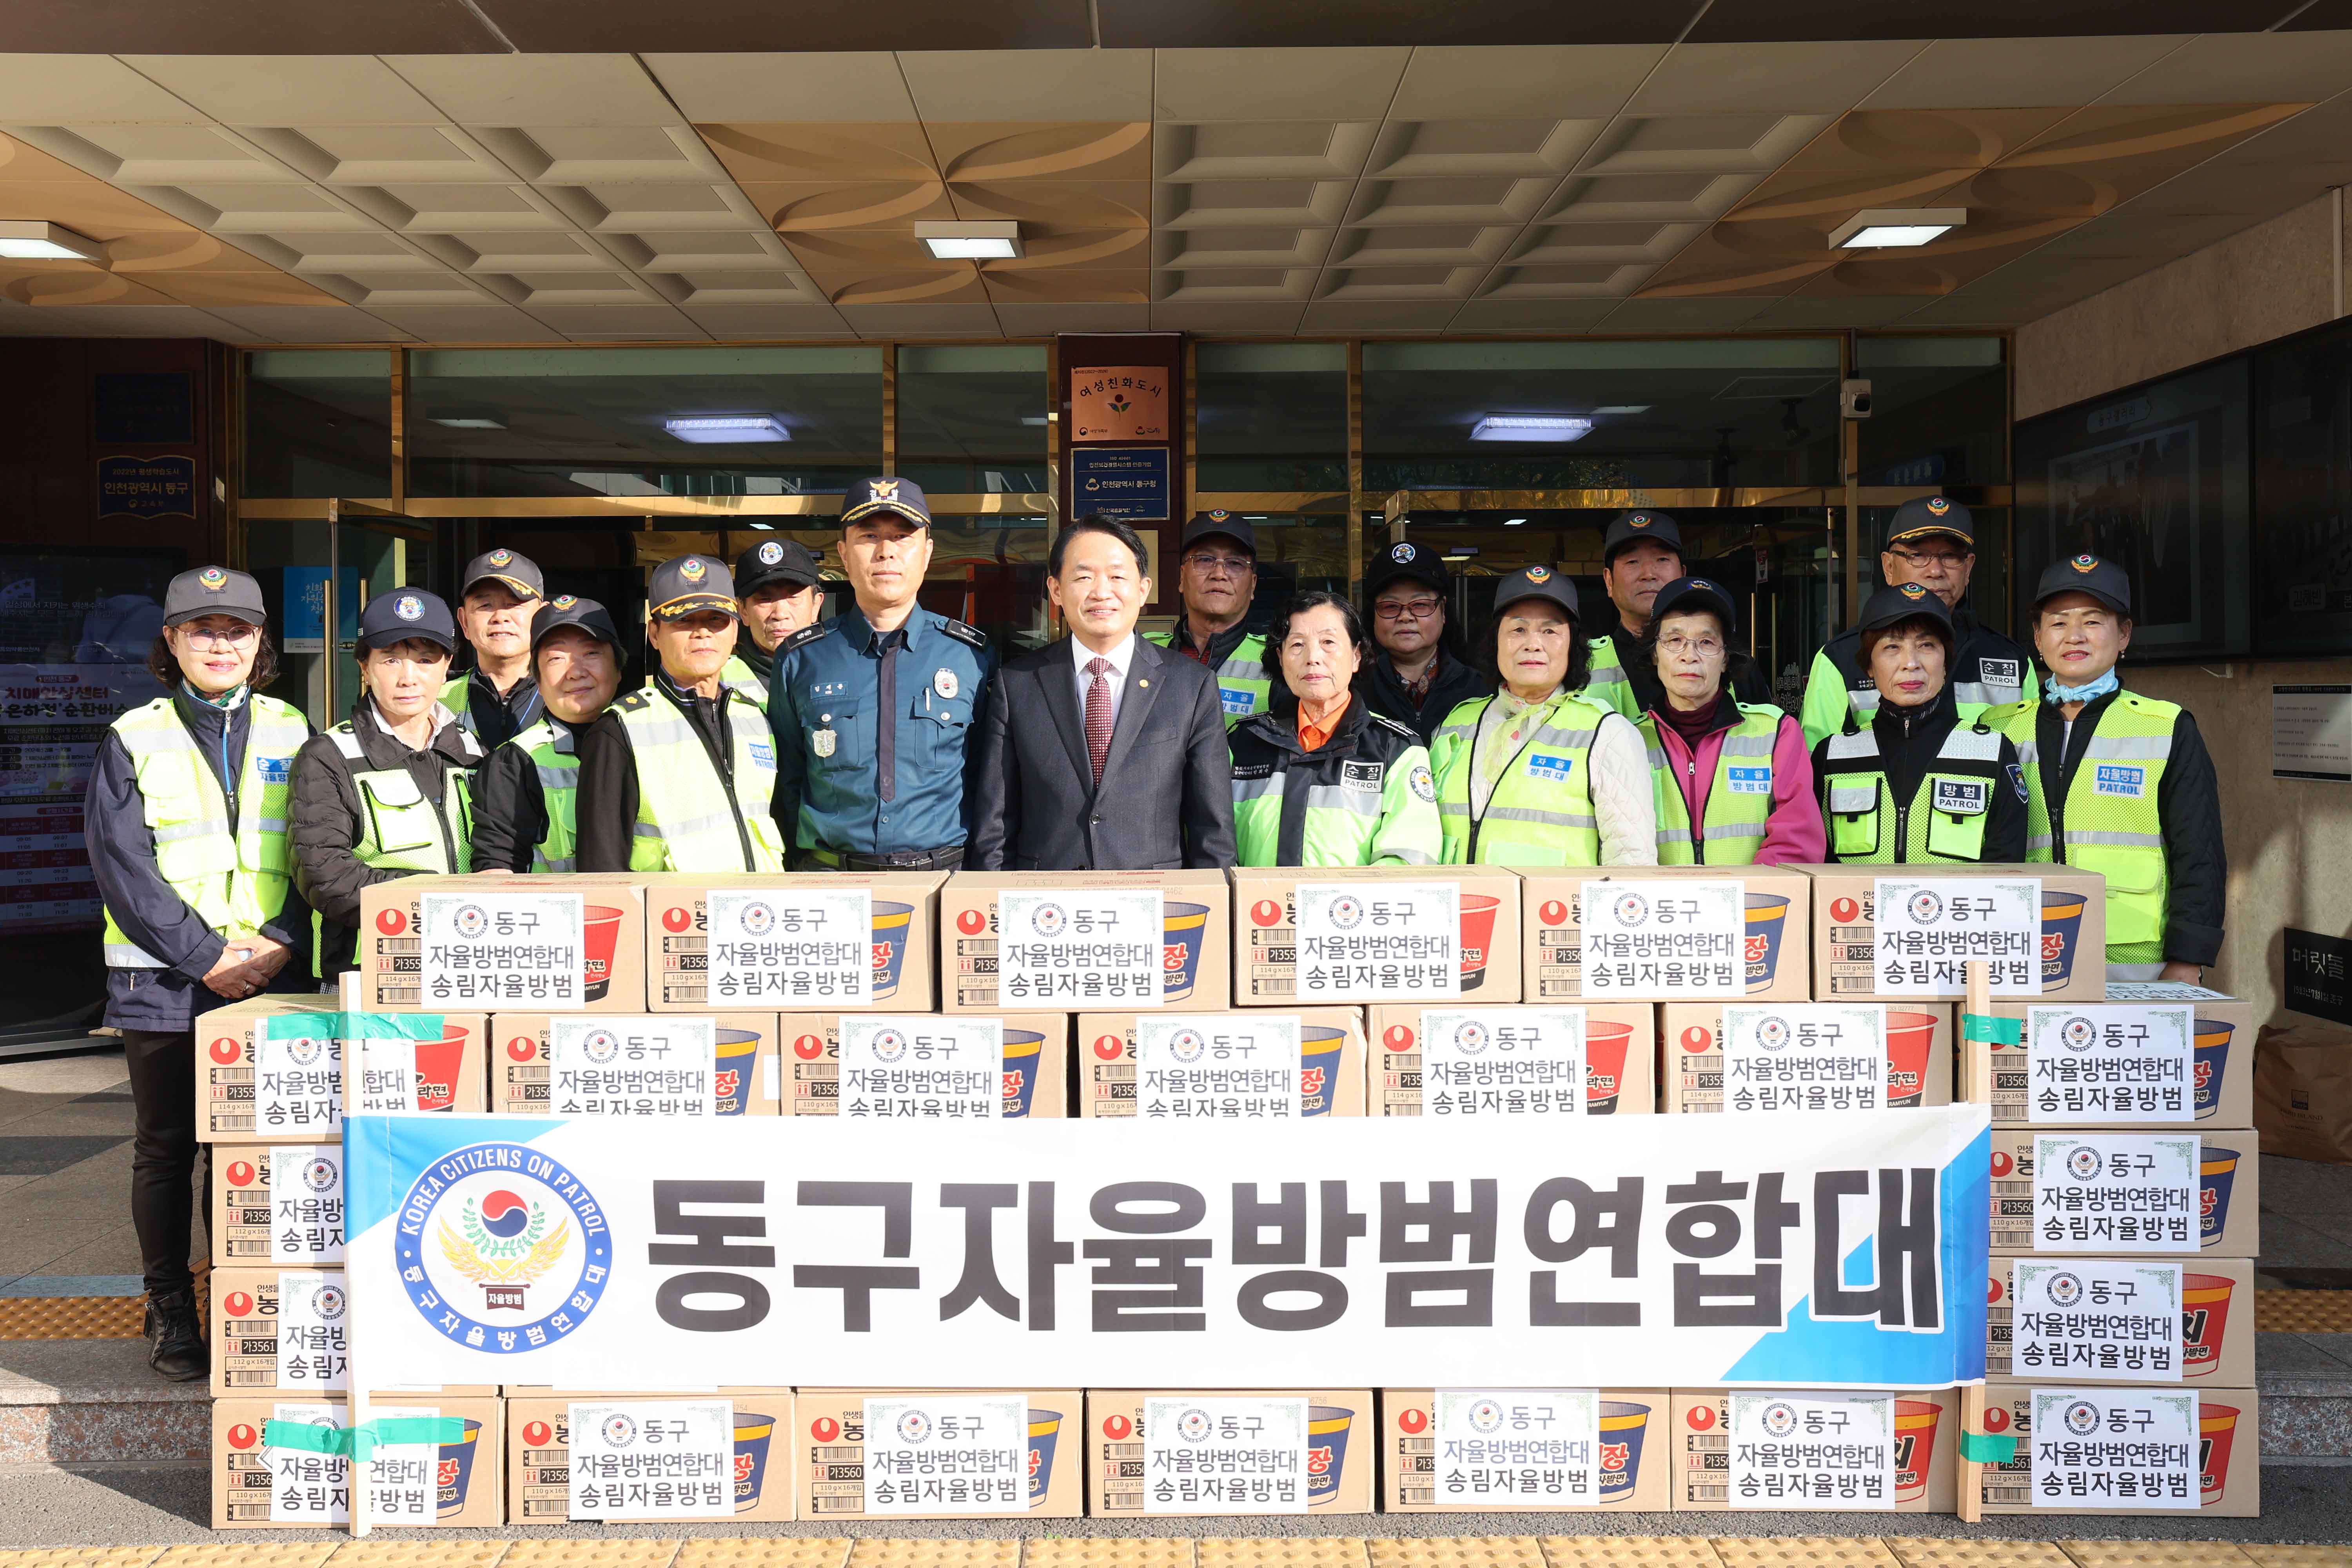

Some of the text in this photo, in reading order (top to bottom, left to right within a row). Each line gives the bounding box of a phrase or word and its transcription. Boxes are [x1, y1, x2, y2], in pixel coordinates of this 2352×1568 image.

[1080, 377, 1162, 397] 여성친화도시
[104, 482, 188, 495] 인천광역시 동구
[1102, 480, 1156, 488] 인천광역시 동구청
[1984, 662, 2014, 675] 순찰
[1985, 675, 2014, 684] PATROL
[5, 686, 109, 700] 치매안심센터
[1224, 692, 1248, 702] 자율
[1346, 766, 1379, 779] 순찰
[1530, 768, 1564, 780] 방범대
[1536, 758, 1565, 769] 자율
[1735, 770, 1764, 779] 자율
[260, 772, 289, 782] 자율방
[1345, 779, 1377, 788] PATROL
[1733, 782, 1768, 791] 방범대
[2099, 768, 2140, 783] 자율방범
[1944, 784, 1975, 798] 방범
[2099, 783, 2139, 794] PATROL
[1940, 799, 1980, 809] PATROL
[782, 909, 827, 932] 동구
[1370, 903, 1416, 925] 동구
[1656, 900, 1700, 923] 동구
[1950, 898, 1996, 921] 동구
[495, 912, 540, 935] 동구
[1074, 910, 1119, 933] 동구
[717, 942, 860, 966] 자율방범연합대
[1305, 936, 1449, 960] 자율방범연합대
[1590, 933, 1733, 957] 자율방범연합대
[1849, 946, 1874, 958] 가356
[1882, 931, 2030, 955] 자율방범연합대
[395, 958, 421, 971] 가355
[430, 945, 573, 969] 자율방범연합대
[682, 956, 707, 969] 가356
[1007, 944, 1152, 967] 자율방범연합대
[1270, 949, 1296, 961] 가355
[2292, 947, 2344, 980] 머릿돌
[718, 971, 858, 995] 송림자율방범
[1009, 973, 1150, 996] 송림자율방범
[1306, 964, 1447, 989] 송림자율방범
[1591, 962, 1732, 986] 송림자율방범
[431, 974, 571, 998] 송림자율방범
[1496, 1028, 1541, 1050] 동구
[1797, 1024, 1843, 1047] 동구
[2103, 1024, 2149, 1047] 동구
[626, 1037, 671, 1060] 동구
[913, 1037, 958, 1060] 동구
[1211, 1036, 1256, 1059] 동구
[1431, 1060, 1575, 1085] 자율방범연합대
[1732, 1057, 1877, 1081] 자율방범연합대
[1999, 1074, 2028, 1086] 가3560
[2036, 1058, 2183, 1082] 자율방범연합대
[229, 1087, 254, 1098] 가355
[559, 1070, 704, 1094] 자율방범연합대
[813, 1083, 838, 1095] 가356
[848, 1069, 991, 1094] 자율방범연합대
[1145, 1069, 1290, 1093] 자율방범연합대
[1432, 1089, 1573, 1114] 송림자율방범
[1733, 1086, 1874, 1111] 송림자율방범
[2038, 1087, 2181, 1111] 송림자율방범
[2109, 1154, 2155, 1177] 동구
[402, 1148, 605, 1236] KOREA CITIZENS ON PATROL
[2042, 1187, 2189, 1212] 자율방범연합대
[245, 1211, 270, 1222] 가356
[2003, 1201, 2033, 1213] 가3560
[2043, 1216, 2187, 1241] 송림자율방범
[648, 1169, 1941, 1333] 동구자율방범연합대
[488, 1293, 522, 1305] 자율방범
[2090, 1281, 2137, 1305] 동구
[257, 1295, 279, 1315] 농
[404, 1265, 606, 1351] 동구자율방범연합대
[2021, 1312, 2172, 1341] 자율방범연합대
[243, 1341, 275, 1352] 가3561
[2022, 1341, 2170, 1370] 송림자율방범
[2183, 1346, 2209, 1357] 사발면
[939, 1417, 984, 1439] 동구
[1219, 1417, 1264, 1439] 동구
[1510, 1407, 1555, 1430] 동구
[1804, 1411, 1850, 1434] 동구
[2107, 1409, 2154, 1433] 동구
[644, 1421, 689, 1443] 동구
[843, 1423, 864, 1441] 농
[873, 1450, 1017, 1474] 자율방범연합대
[1153, 1449, 1297, 1473] 자율방범연합대
[1444, 1440, 1588, 1464] 자율방범연합대
[1738, 1443, 1884, 1469] 자율방범연합대
[2040, 1442, 2188, 1468] 자율방범연합대
[281, 1457, 428, 1485] 자율방연합대
[542, 1470, 569, 1482] 가356
[578, 1453, 722, 1478] 자율방범연합대
[830, 1467, 862, 1478] 가3560
[246, 1474, 272, 1485] 가356
[875, 1478, 1016, 1503] 송림자율방범
[1154, 1478, 1294, 1502] 송림자율방범
[1446, 1469, 1586, 1493] 송림자율방범
[1599, 1474, 1625, 1484] 사발면
[1739, 1473, 1882, 1498] 송림자율방범
[2041, 1472, 2187, 1497] 송림자율방범
[281, 1487, 424, 1514] 송림자방범
[579, 1482, 721, 1508] 송림자율방범
